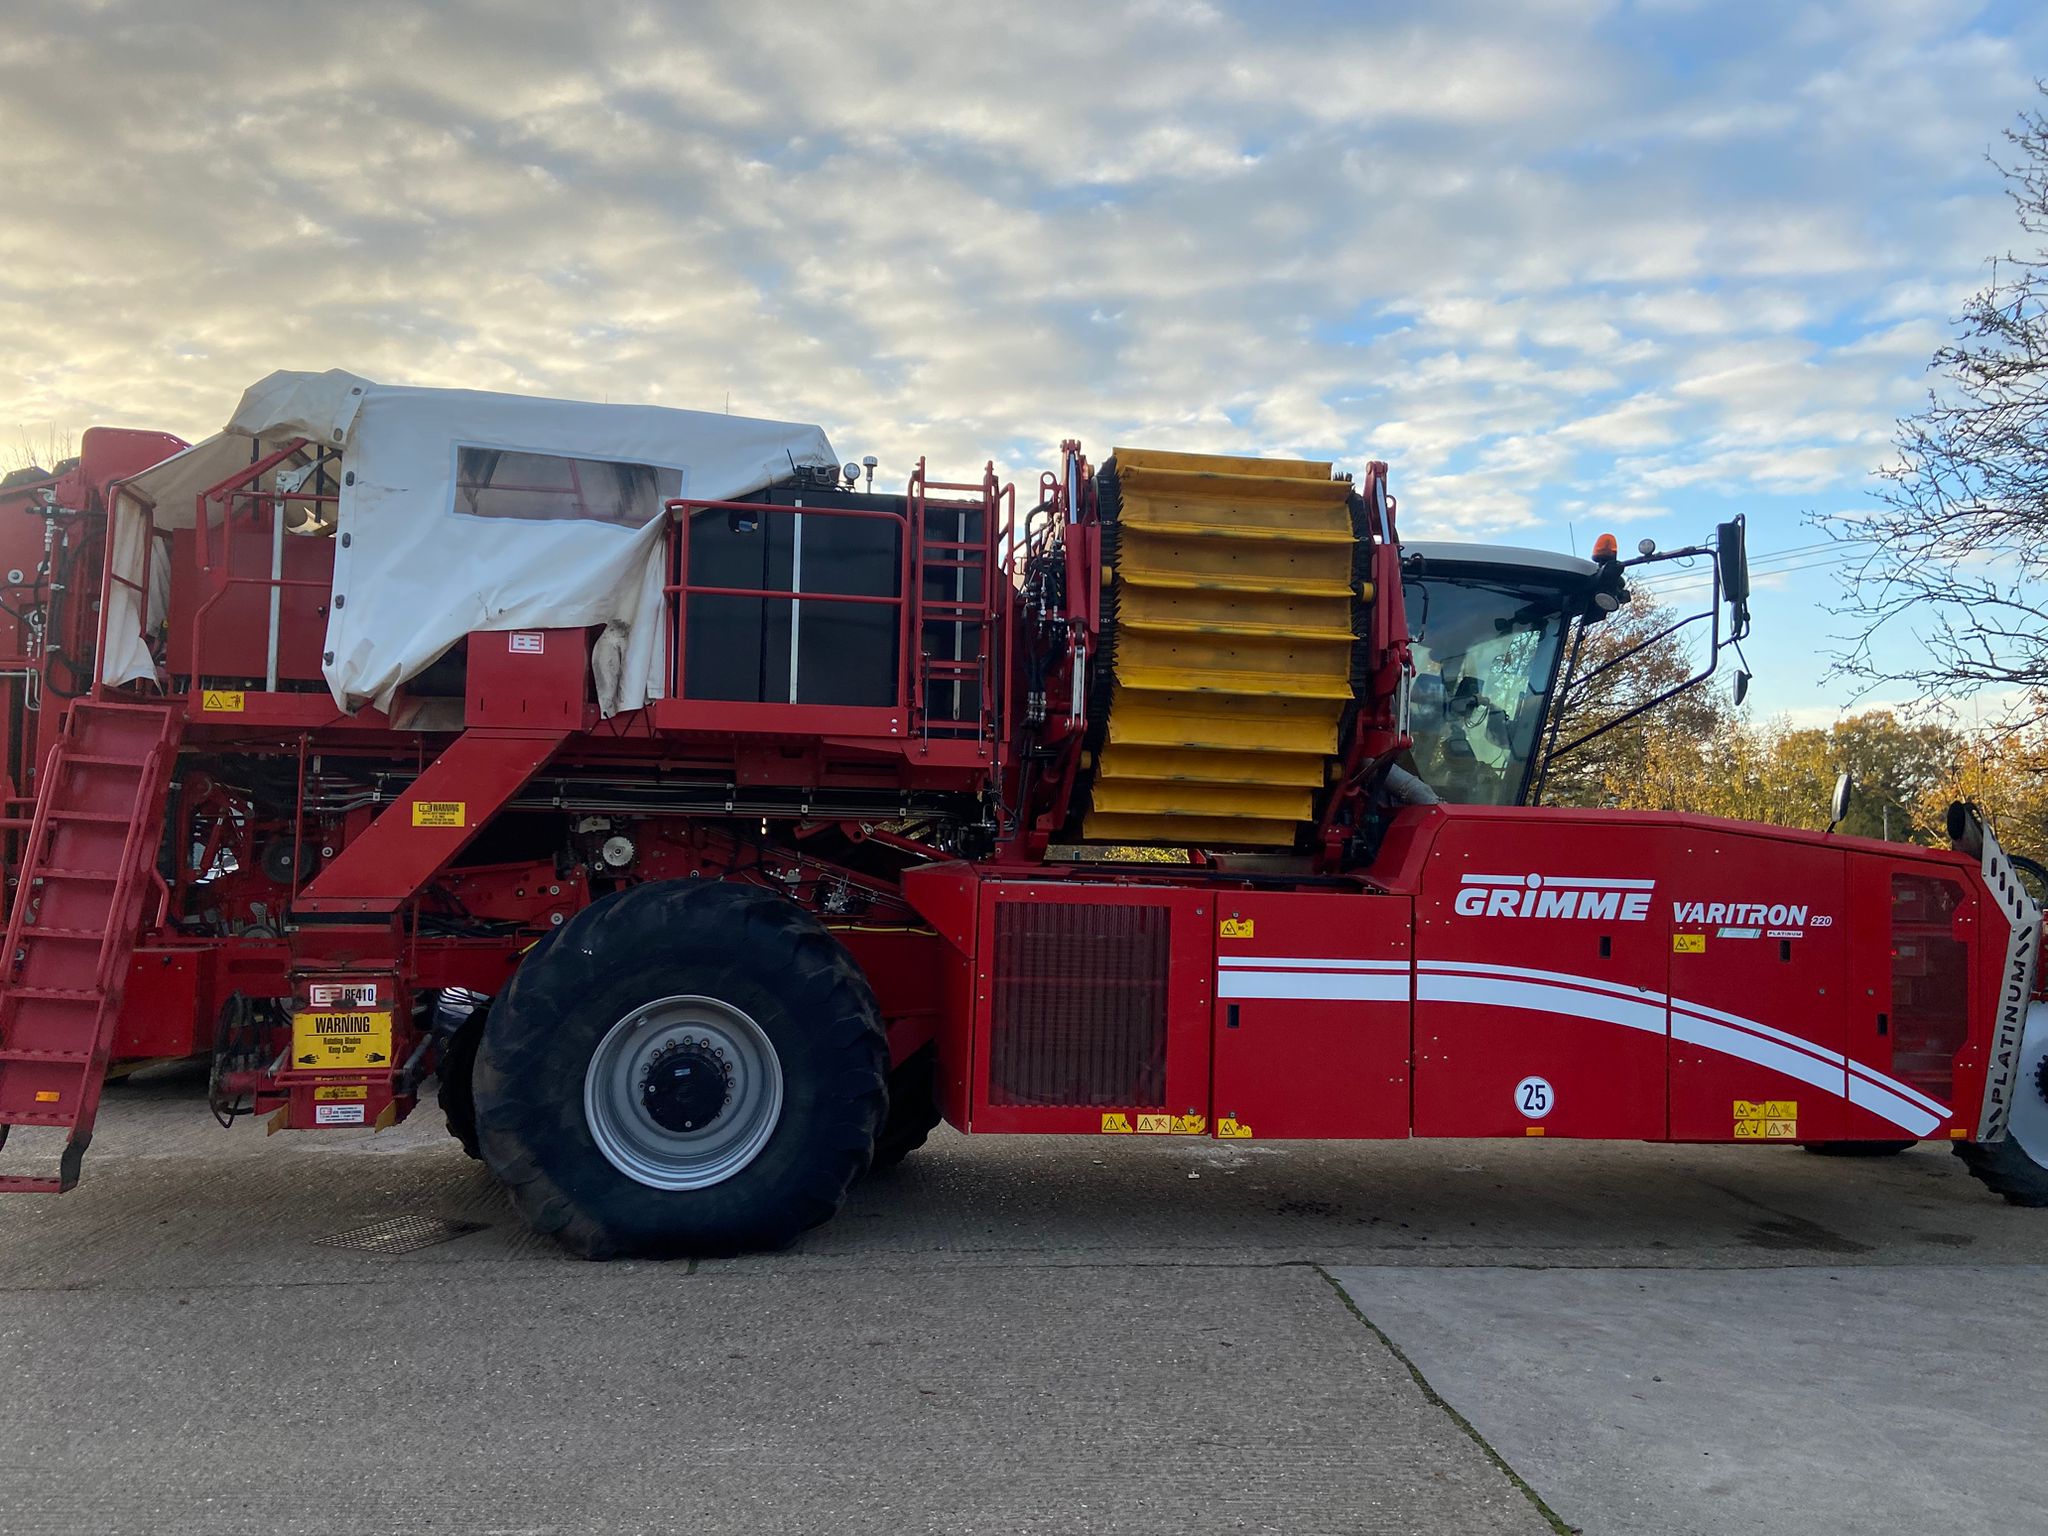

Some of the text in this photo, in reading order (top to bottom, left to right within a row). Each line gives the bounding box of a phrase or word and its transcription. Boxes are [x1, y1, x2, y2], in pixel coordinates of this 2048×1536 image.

[1454, 872, 1653, 922] GRIMME
[1673, 901, 1832, 926] VARITRON 220
[315, 1016, 370, 1033] WARNING
[1991, 960, 2027, 1104] PLATINUM
[1523, 1084, 1546, 1111] 25
